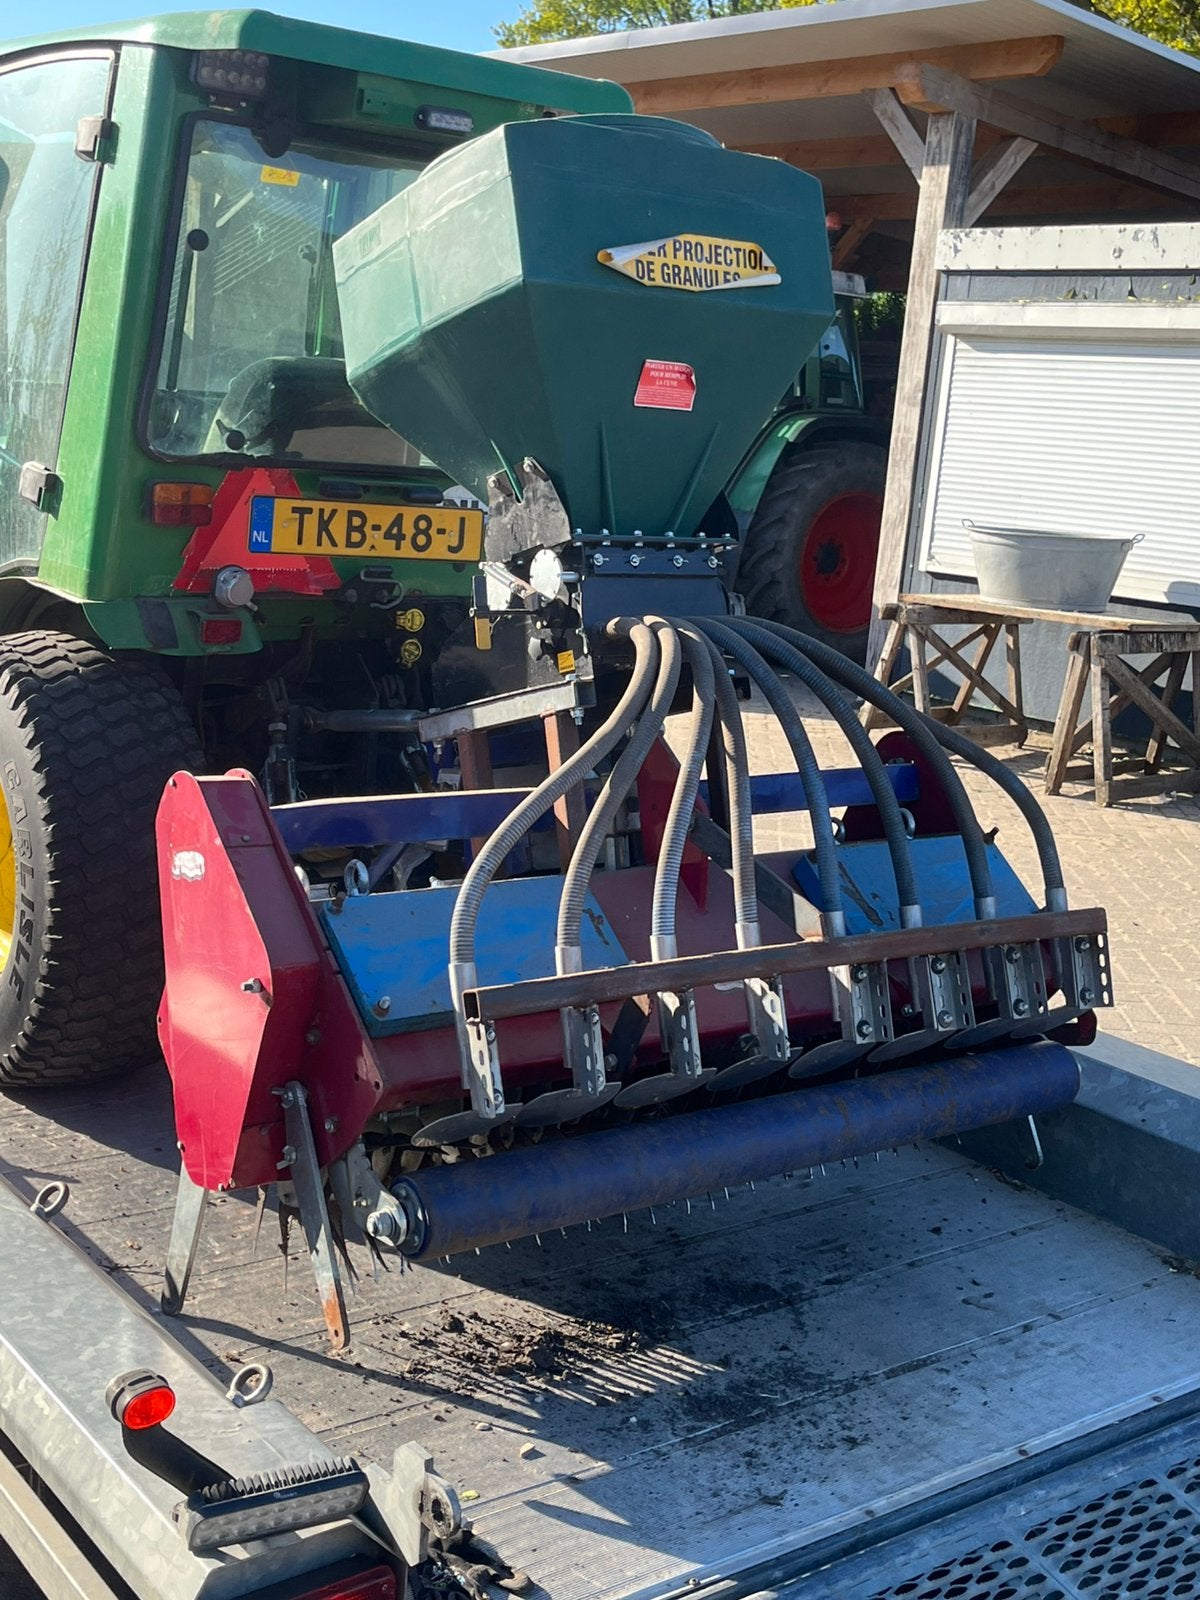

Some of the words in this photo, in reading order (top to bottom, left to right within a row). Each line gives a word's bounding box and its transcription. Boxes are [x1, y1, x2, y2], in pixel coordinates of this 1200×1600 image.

[635, 258, 656, 282] DE
[252, 531, 269, 544] NL
[291, 506, 466, 554] TKB-48-J
[4, 760, 35, 1001] CARLISLE
